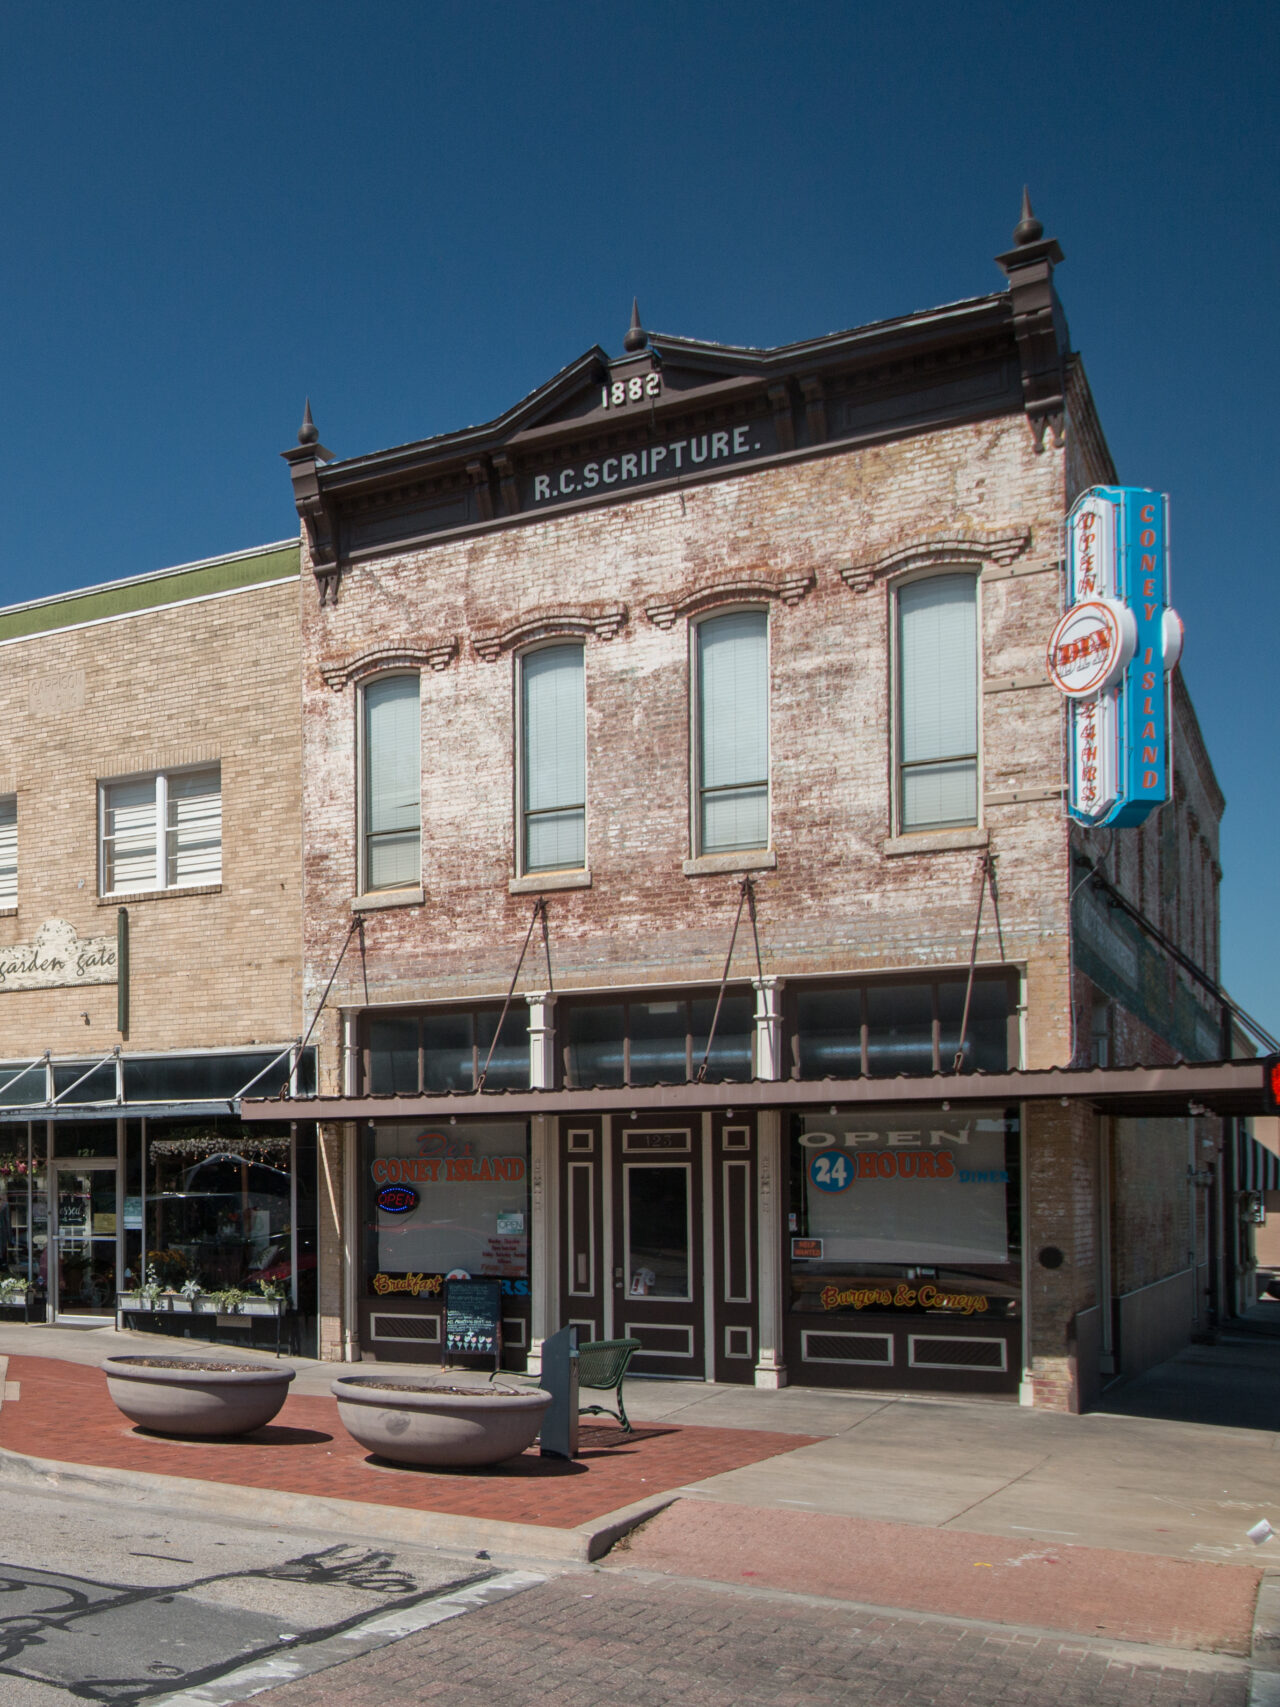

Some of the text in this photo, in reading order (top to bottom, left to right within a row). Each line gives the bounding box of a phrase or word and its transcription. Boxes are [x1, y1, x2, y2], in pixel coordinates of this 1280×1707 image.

[602, 373, 661, 409] 1882
[1077, 511, 1096, 595] OPEN
[1139, 505, 1159, 791] CONEY ISLAND
[76, 946, 116, 976] gate
[798, 1130, 970, 1147] OPEN
[372, 1156, 525, 1183] CONEY ISLAND
[815, 1151, 955, 1187] 24 HOURS
[958, 1170, 1010, 1183] DINER
[378, 1193, 415, 1206] OPEN
[374, 1272, 442, 1296] Breakfast
[821, 1284, 989, 1316] Burgers & Coneys
